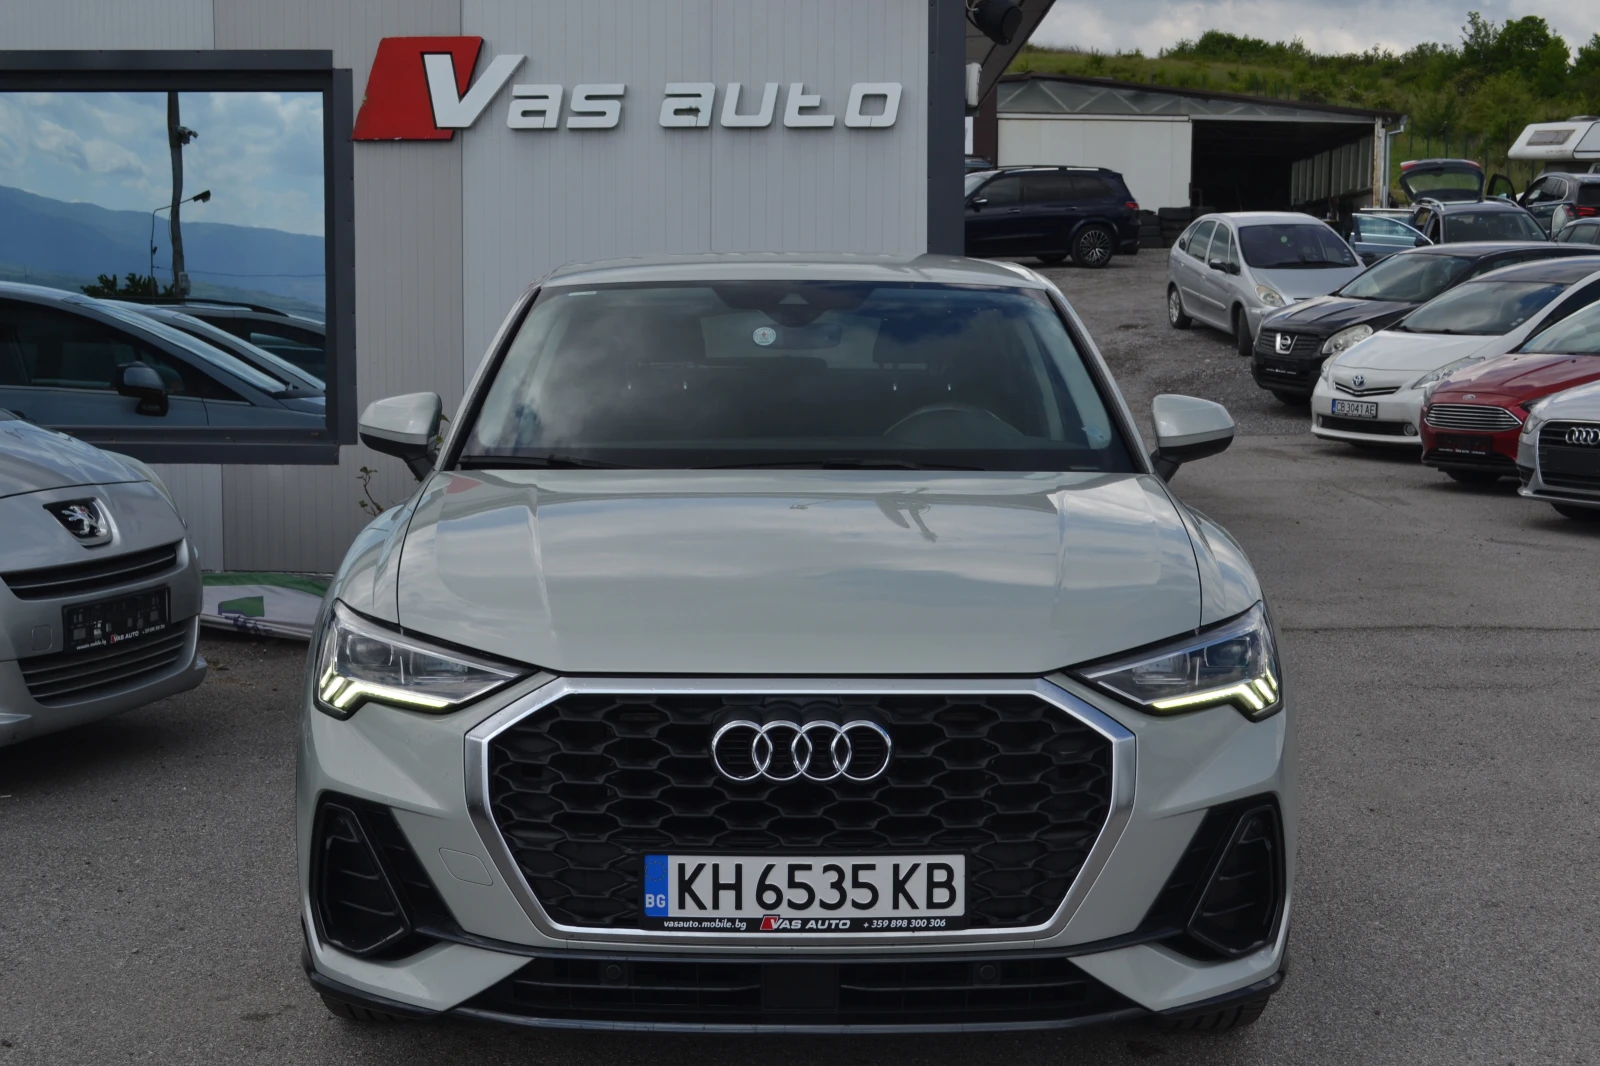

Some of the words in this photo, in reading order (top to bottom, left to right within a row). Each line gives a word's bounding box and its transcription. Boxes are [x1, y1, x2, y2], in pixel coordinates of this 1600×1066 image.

[658, 82, 903, 128] auto
[645, 893, 666, 908] BG
[663, 918, 747, 931] vasauto.mobile.bg
[770, 918, 802, 930] VAS
[805, 919, 851, 930] AUTO
[890, 919, 908, 928] 898
[909, 919, 927, 928] 300
[929, 918, 946, 928] 306
